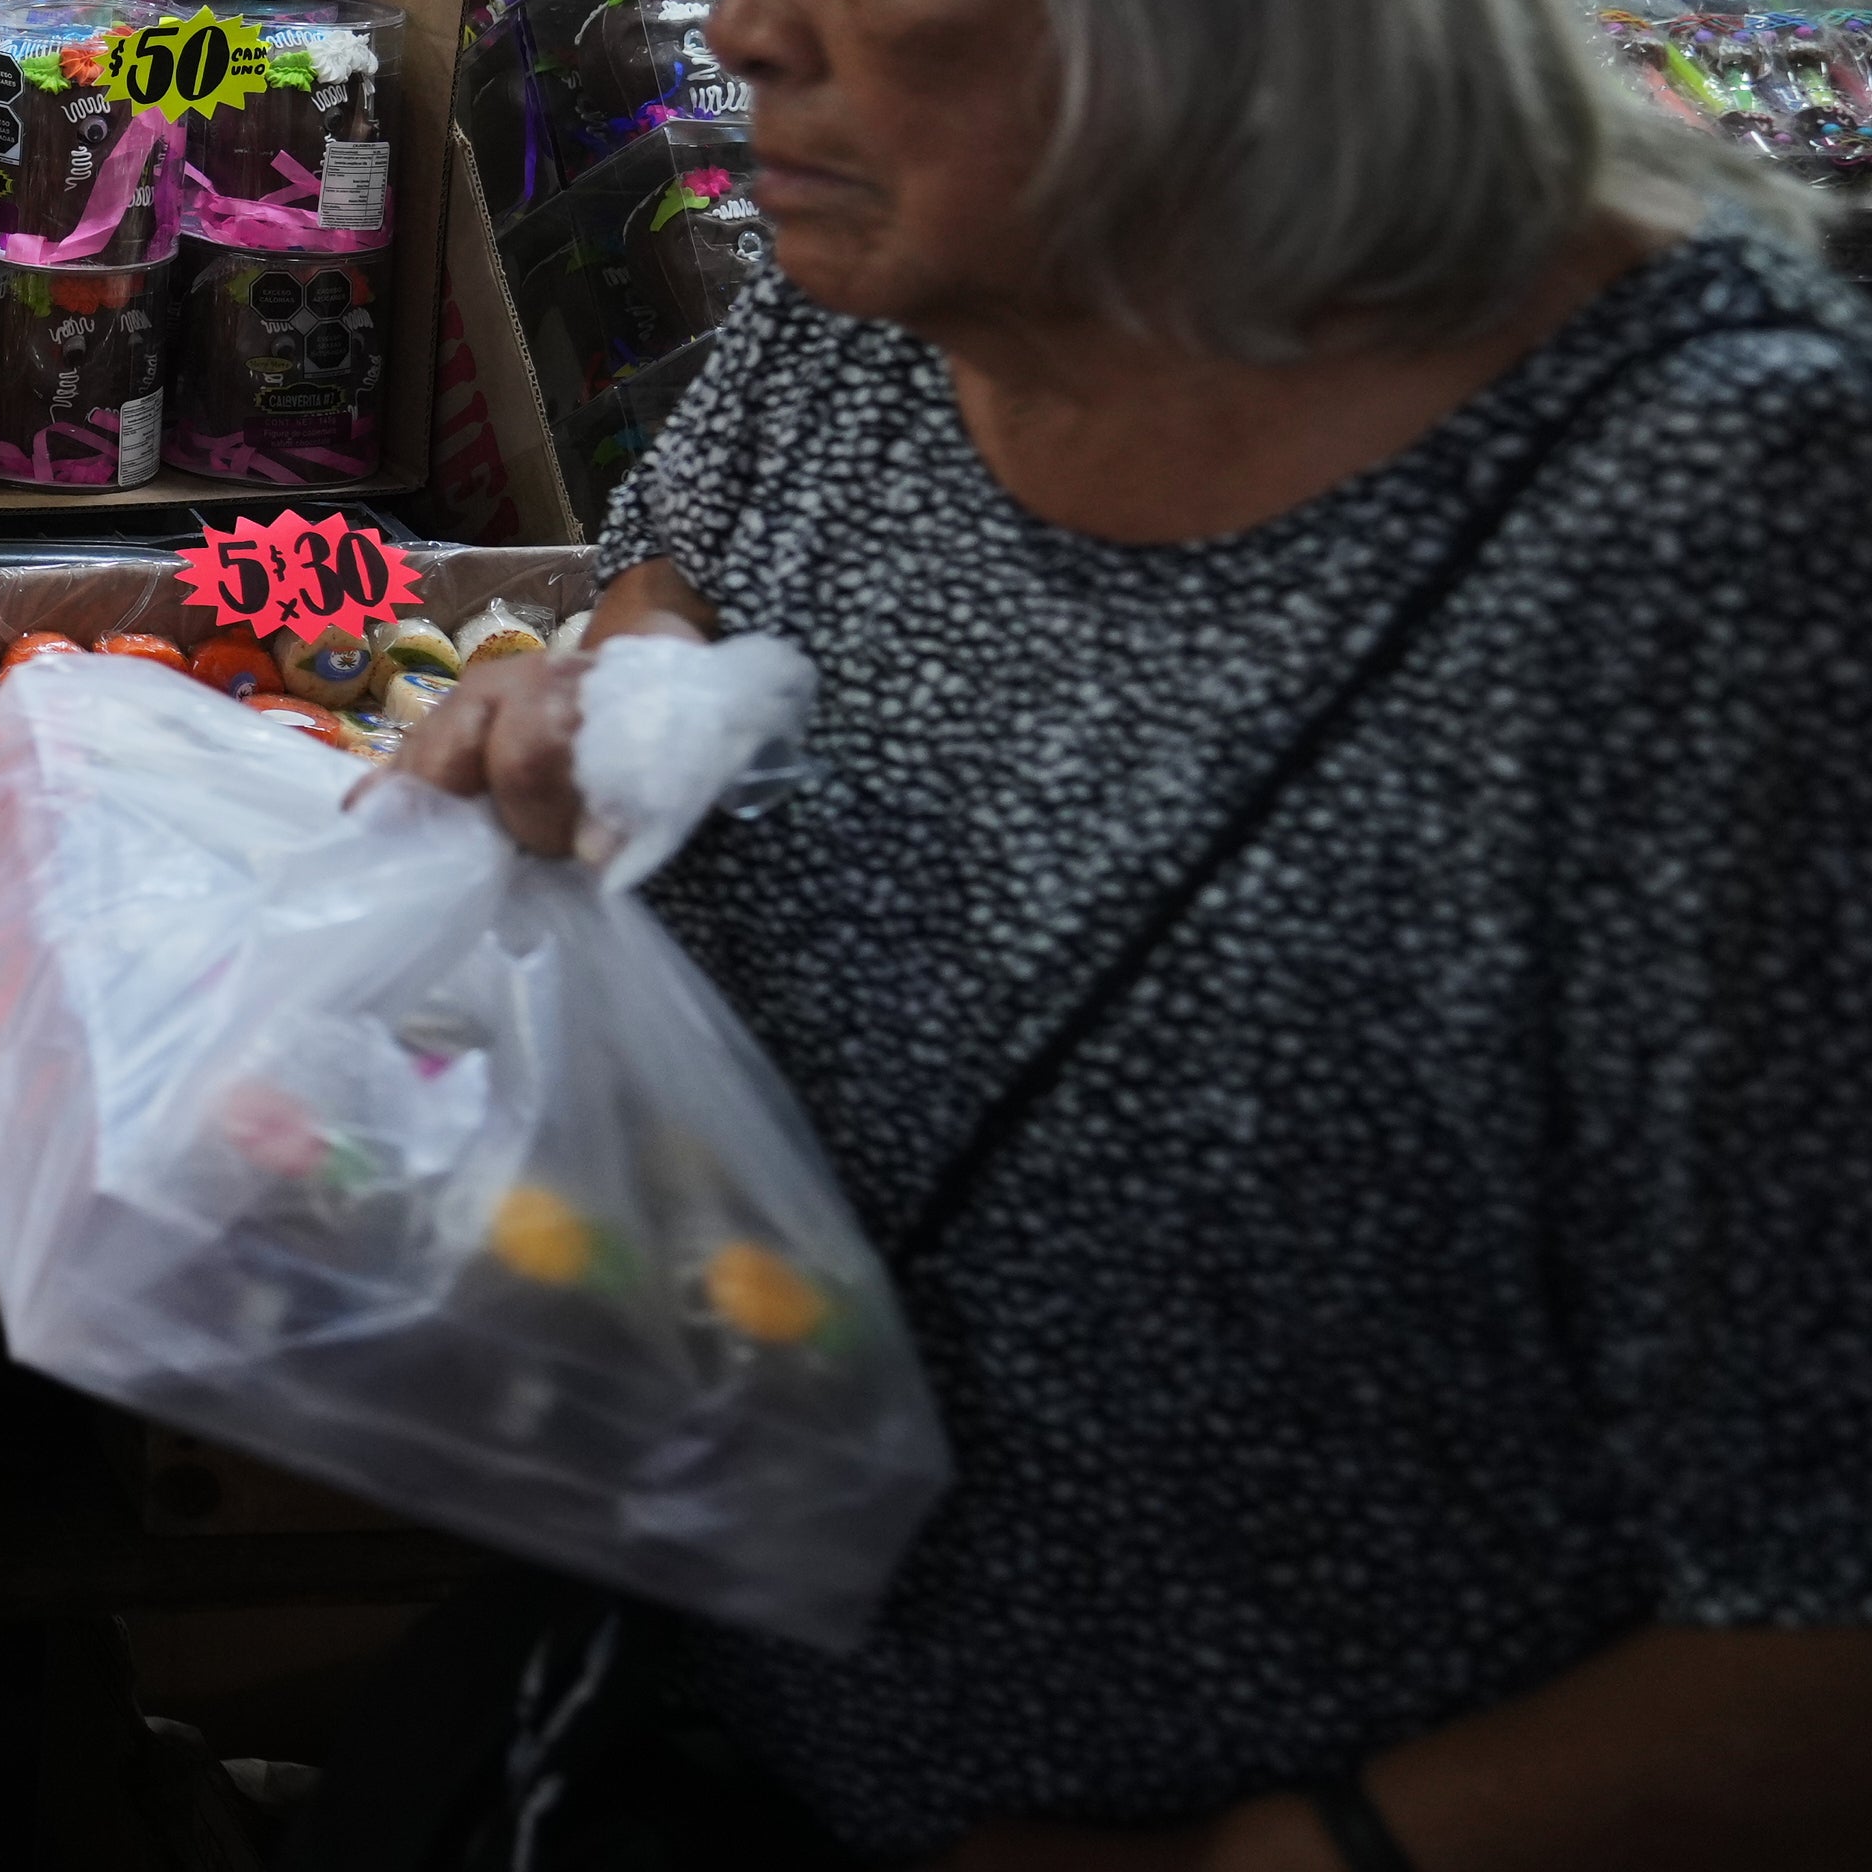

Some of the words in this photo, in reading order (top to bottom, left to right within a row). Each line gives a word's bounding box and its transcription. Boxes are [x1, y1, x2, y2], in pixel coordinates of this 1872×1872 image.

[231, 47, 267, 62] CADA
[109, 26, 230, 105] $50
[231, 64, 265, 75] UNO
[259, 296, 295, 304] CALORIAS
[218, 540, 270, 614] 5
[294, 531, 389, 616] 30
